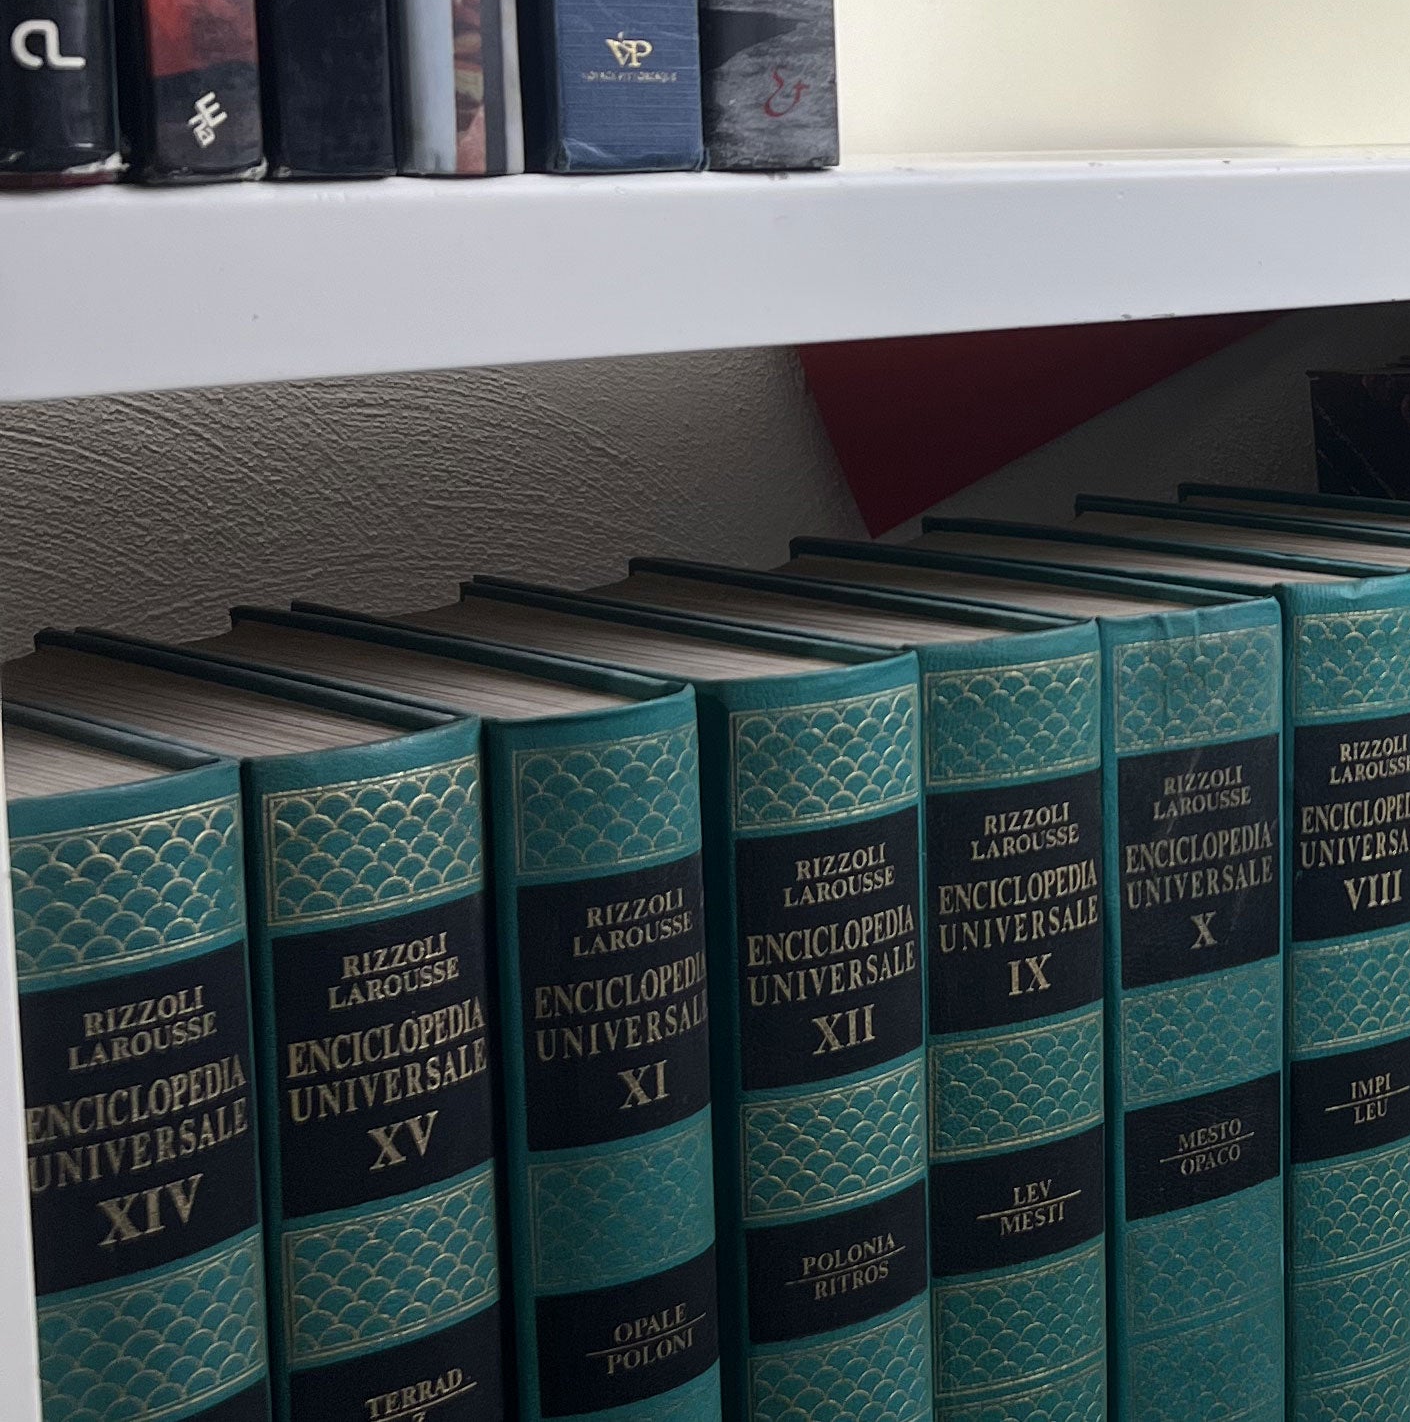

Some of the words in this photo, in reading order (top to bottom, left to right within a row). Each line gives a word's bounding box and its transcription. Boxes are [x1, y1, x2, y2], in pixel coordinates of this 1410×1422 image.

[1340, 733, 1408, 763] RIZZOLI
[1152, 785, 1252, 821] LAROUSSE
[1164, 764, 1243, 796] RIZZOLI
[984, 801, 1070, 836] RIZZOLI
[795, 841, 887, 881] RIZZOLI
[970, 823, 1080, 861] LAROUSSE
[1126, 821, 1274, 874] ENCICLOPEDIA
[782, 865, 896, 908] LAROUSSE
[938, 858, 1098, 916] ENCICLOPEDIA
[1126, 855, 1274, 910] UNIVERSALE
[1343, 868, 1403, 912] VIII
[586, 888, 684, 929] RIZZOLI
[939, 894, 1099, 953] UNIVERSALE
[1190, 910, 1218, 950] X
[341, 931, 448, 979] RIZZOLI
[572, 910, 694, 957] LAROUSSE
[747, 904, 915, 967] ENCICLOPEDIA
[327, 955, 460, 1011] LAROUSSE
[747, 940, 916, 1007] UNIVERSALE
[1007, 952, 1053, 997] IX
[84, 985, 204, 1038] RIZZOLI
[812, 1003, 876, 1055] XII
[67, 1011, 218, 1071] LAROUSSE
[287, 995, 487, 1079] ENCICLOPEDIA
[24, 1054, 247, 1145] ENCICLOPEDIA
[287, 1036, 488, 1123] UNIVERSALE
[617, 1059, 671, 1110] XI
[1350, 1072, 1391, 1099] IMPI
[1178, 1117, 1242, 1153] MESTO
[1354, 1098, 1389, 1126] LEU
[28, 1097, 249, 1193] UNIVERSALE
[366, 1110, 440, 1171] XV
[1180, 1143, 1241, 1176] OPACO
[97, 1173, 205, 1246] XIV
[1013, 1178, 1053, 1207] LEV
[1000, 1200, 1065, 1237] MESTI
[803, 1232, 896, 1277] POLONIA
[815, 1260, 890, 1300] RITROS
[613, 1303, 687, 1346] OPALE
[606, 1327, 695, 1376] POLONI
